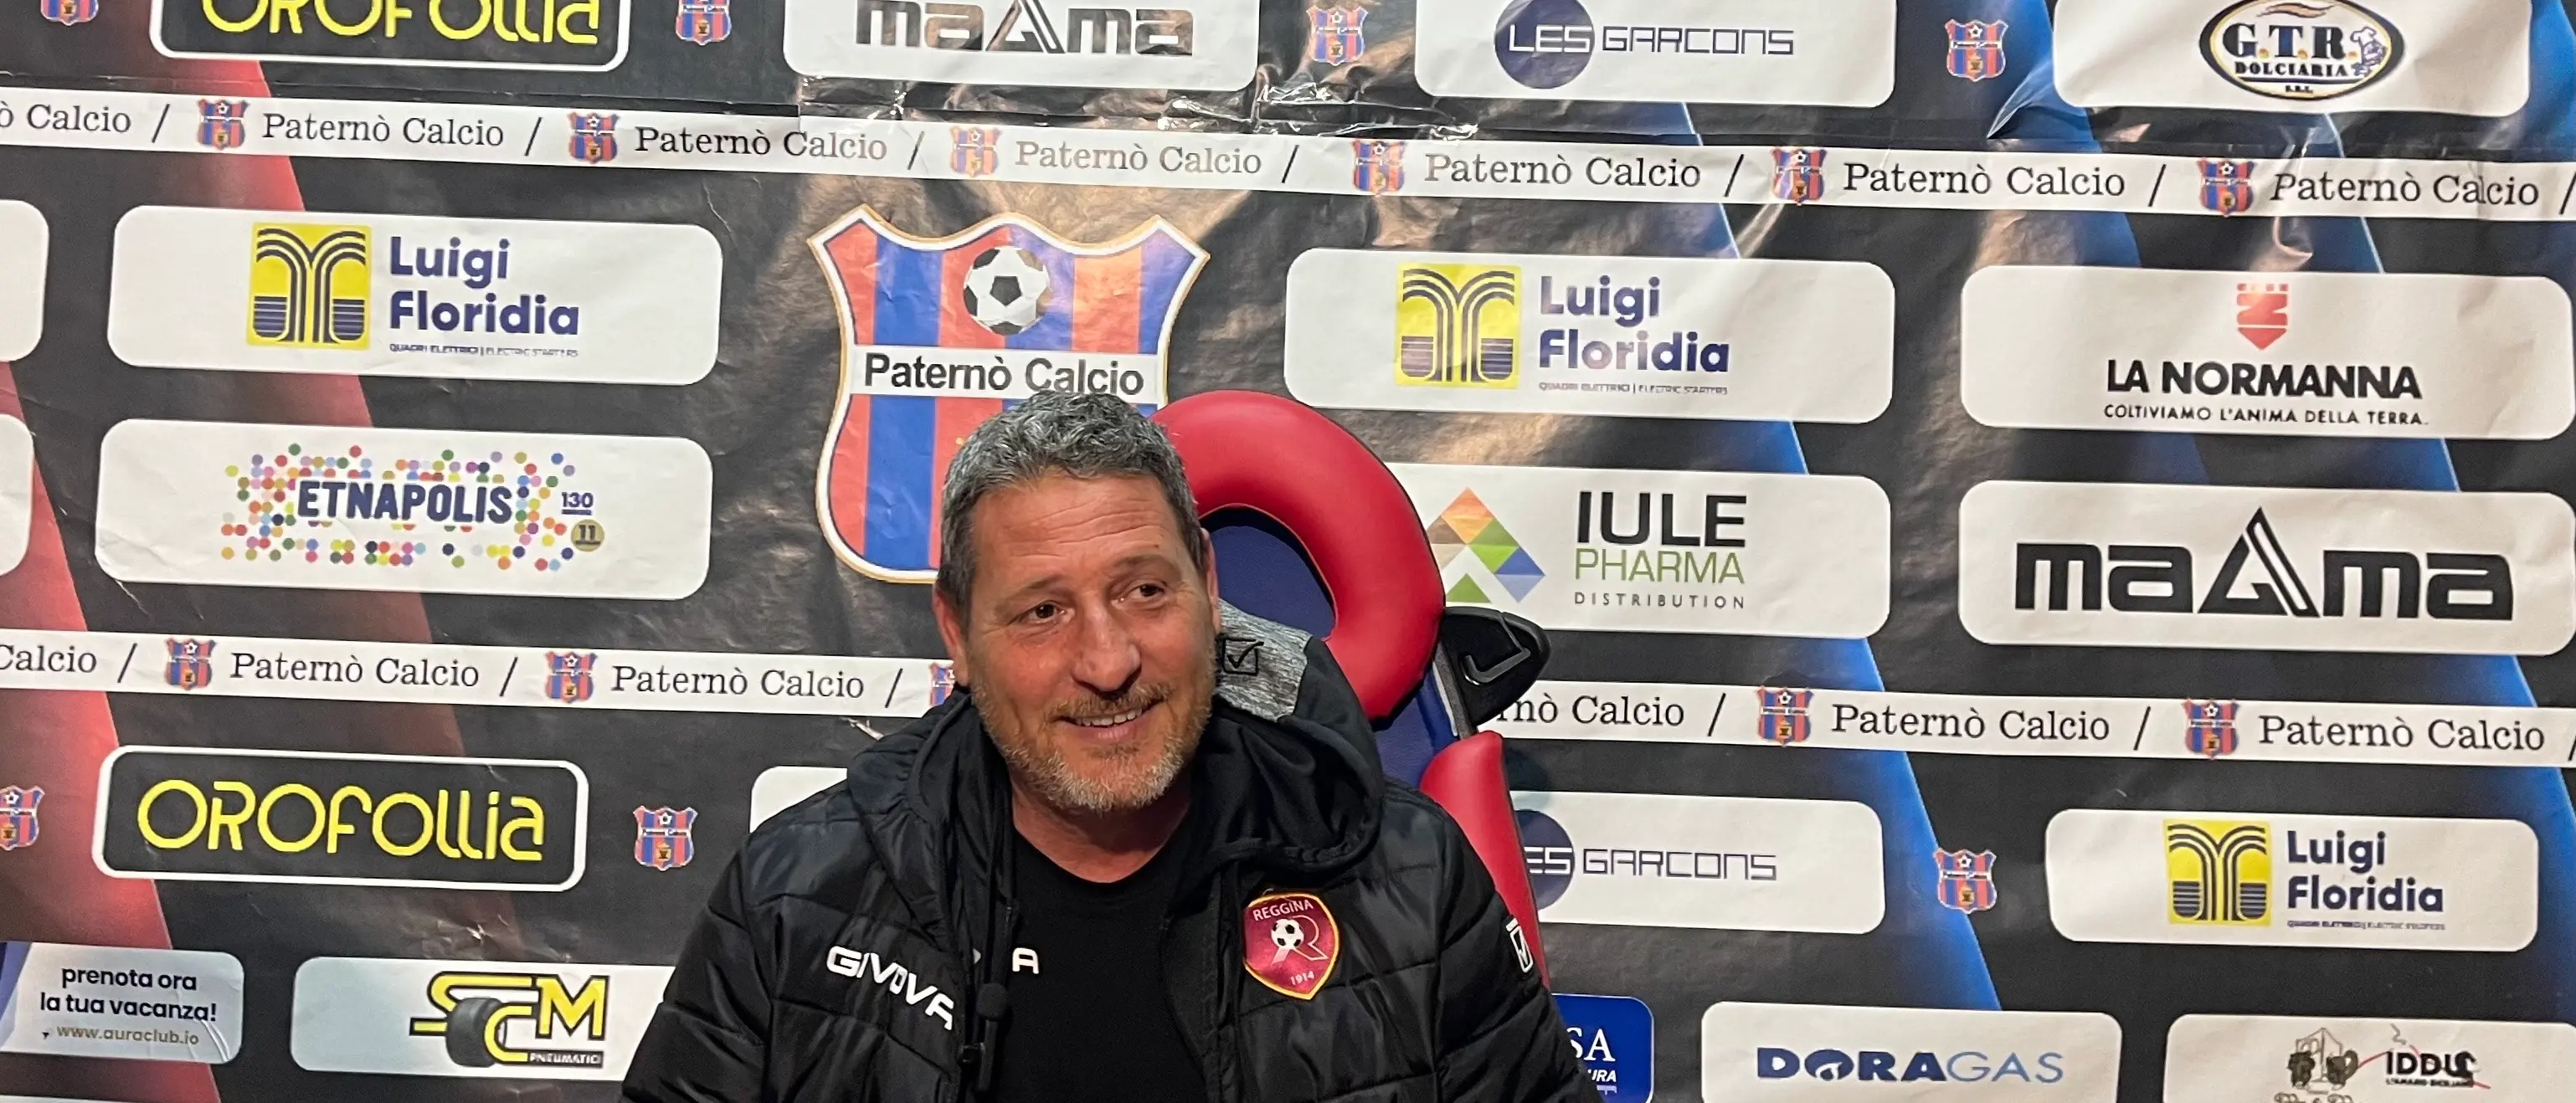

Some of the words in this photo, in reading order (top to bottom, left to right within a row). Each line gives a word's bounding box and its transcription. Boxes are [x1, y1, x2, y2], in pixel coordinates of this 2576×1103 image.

[1507, 21, 1592, 57] LES
[2234, 60, 2349, 79] DOLCIARIA
[26, 104, 131, 133] Calcio
[261, 112, 390, 142] Paternò
[403, 117, 504, 146] Calcio
[634, 125, 771, 156] Paternò
[783, 129, 888, 162] Calcio
[1015, 141, 1149, 172] Paternò
[1159, 146, 1262, 174] Calcio
[1424, 153, 1572, 185] Paternò
[1586, 156, 1701, 187] Calcio
[1843, 162, 1992, 195] Paternò
[2006, 166, 2126, 197] Calcio
[2269, 171, 2422, 202] Paternò
[2432, 173, 2539, 206] Calcio
[389, 236, 511, 290] Luigi
[389, 290, 579, 336] Floridia
[1540, 274, 1661, 328] Luigi
[1539, 328, 1730, 373] Floridia
[863, 351, 1015, 393] Paternò
[1023, 355, 1147, 400] Calcio
[2107, 359, 2151, 393] LA
[2161, 361, 2423, 400] NORMANNA
[2103, 403, 2212, 421] COLTIVIAMO
[2219, 408, 2298, 423] L'ANIMA
[2305, 409, 2360, 424] DELLA
[2366, 409, 2429, 427] TERRA.
[296, 480, 512, 523] ETNAPOLIS
[561, 491, 594, 509] 130
[1576, 490, 1747, 548] IULE
[1575, 548, 1746, 585] PHARMA
[1574, 591, 1744, 610] DISTRIBUTION
[229, 652, 363, 683] Paternò
[375, 657, 479, 687] Calcio
[610, 665, 748, 695] Paternò
[760, 669, 865, 699] Calcio
[1571, 695, 1684, 727] Calcio
[1831, 703, 1986, 739] Paternò
[1999, 710, 2110, 741] Calcio
[2258, 715, 2414, 747] Paternò
[2427, 719, 2545, 752] Calcio
[1524, 847, 1573, 875] ES
[2286, 829, 2386, 874] Luigi
[1252, 899, 1314, 923] REGGINA
[2287, 875, 2444, 913] Floridia
[61, 967, 153, 989] prenota
[157, 974, 198, 992] ora
[827, 946, 956, 1031] GIVOVA
[1290, 971, 1315, 987] 1914
[40, 991, 61, 1012] la
[65, 993, 105, 1014] tua
[111, 998, 219, 1023] vacanza!
[56, 1026, 199, 1045] www.auraclub.io
